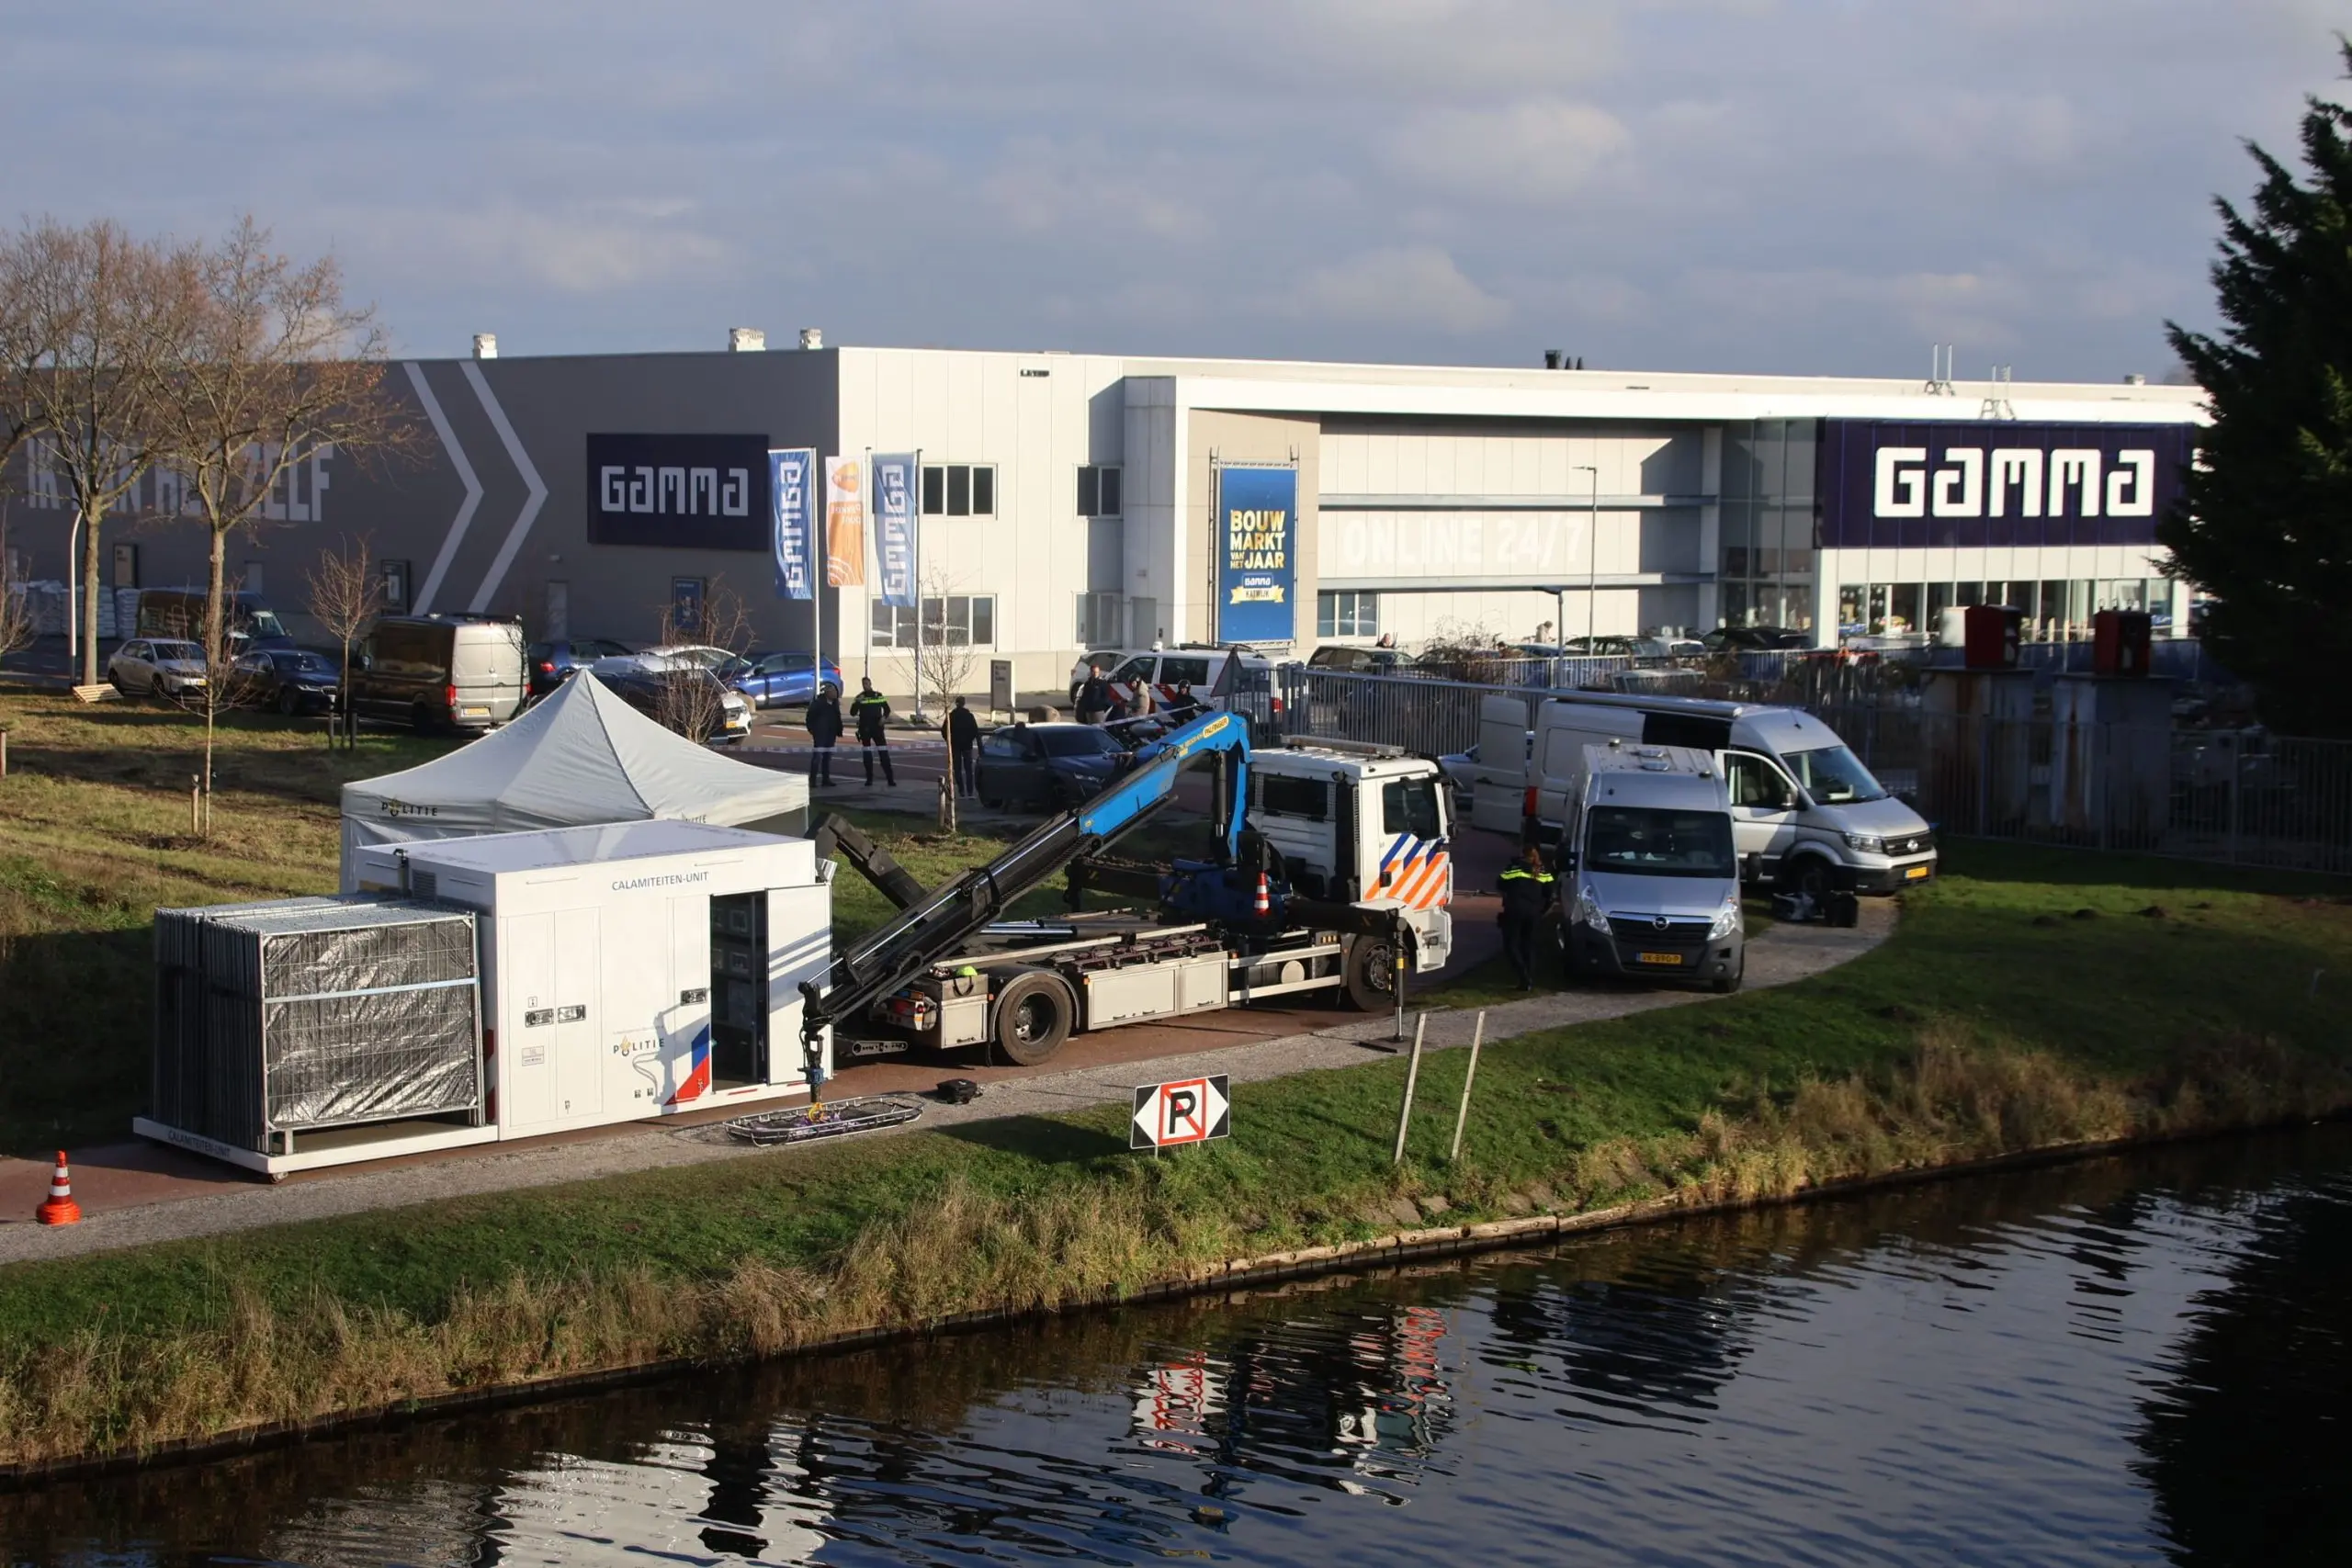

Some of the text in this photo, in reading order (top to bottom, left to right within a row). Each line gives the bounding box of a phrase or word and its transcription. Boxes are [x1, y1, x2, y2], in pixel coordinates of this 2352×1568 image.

[602, 466, 749, 516] GAMMA
[1874, 447, 2154, 517] GAMMA
[1230, 510, 1285, 532] BOUW
[1230, 532, 1285, 550] MARKT
[1342, 513, 1586, 568] ONLINE 24/7
[1230, 552, 1244, 560] VAN
[1244, 551, 1284, 570] JAAR
[381, 797, 438, 818] POLITIE
[611, 871, 708, 891] CALAMITEITEN-UNIT
[613, 1037, 665, 1056] POLITIE
[1169, 1090, 1196, 1134] P
